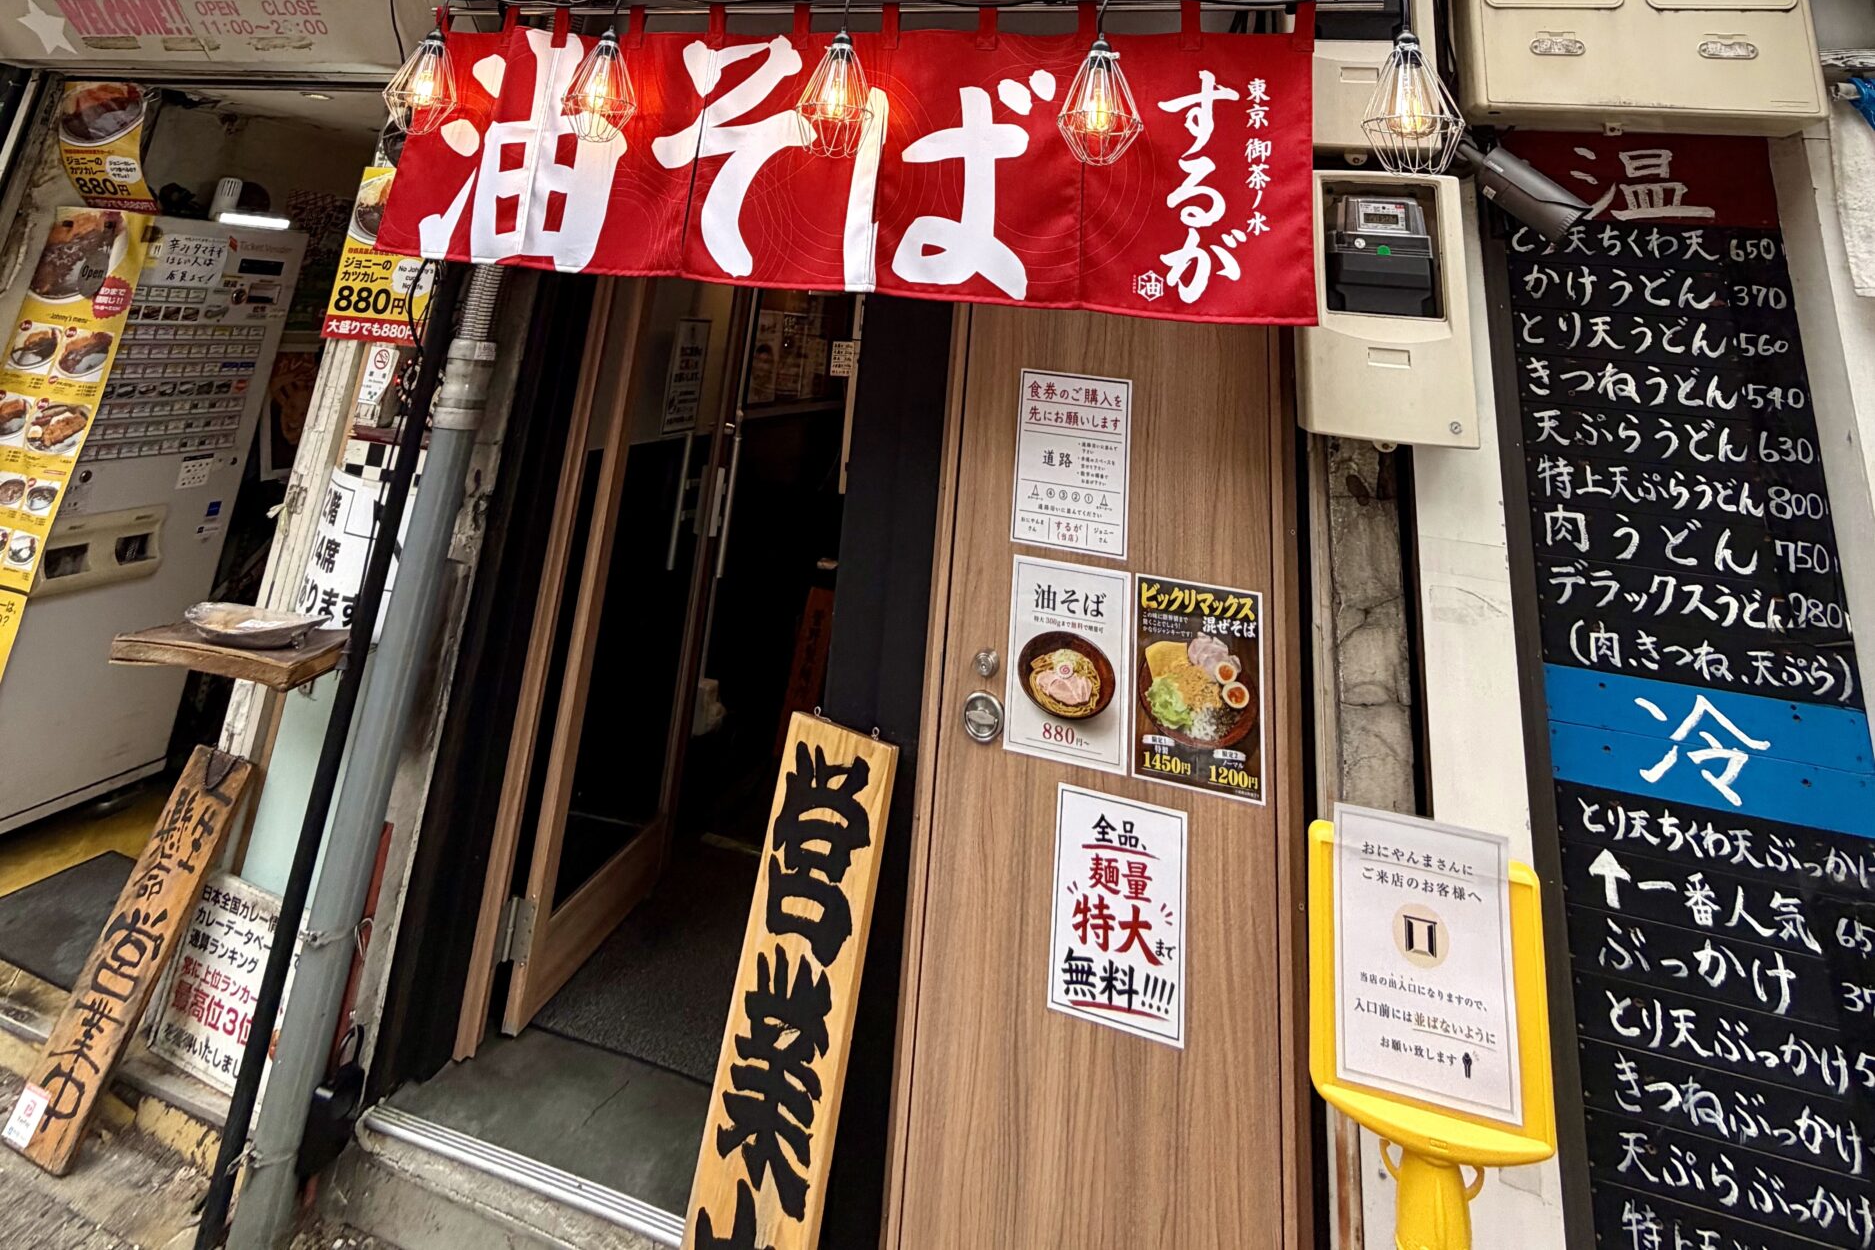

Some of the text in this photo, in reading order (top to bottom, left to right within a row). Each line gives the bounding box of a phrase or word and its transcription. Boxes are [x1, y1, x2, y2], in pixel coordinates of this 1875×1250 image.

[195, 0, 321, 17] OPEN CLOSE
[417, 28, 1056, 300] 油そば
[1244, 78, 1272, 236] 東京 御茶ノ水
[76, 177, 131, 196] 880円
[1157, 70, 1247, 304] するが
[1570, 147, 1716, 221] 温
[344, 256, 392, 270] ジョニーの
[1730, 238, 1775, 261] 650
[81, 265, 105, 281] Open
[340, 270, 389, 283] カツカレー
[1139, 272, 1163, 298] 油
[1523, 264, 1787, 310] かけうどん 370
[334, 285, 405, 316] 880円
[1520, 312, 1789, 358] とり天うどん 560
[1027, 380, 1123, 408] 食券のご購入を
[1526, 356, 1805, 410] きつねうどん 540
[1028, 405, 1121, 431] 先にお願いします
[1533, 409, 1814, 464] 天ぷらうどん 630
[1042, 449, 1073, 468] 道路
[1537, 454, 1825, 520] 特上天ぷらうどん 800
[1055, 520, 1083, 533] するが
[1544, 504, 1830, 575] 肉うどん 750
[1034, 583, 1107, 618] 油そば
[1140, 581, 1256, 621] ビックリマックス
[1549, 560, 1788, 633] デラックスうどん
[1202, 616, 1257, 639] 混ぜそば
[1143, 751, 1191, 776] 1450円
[1634, 694, 1771, 807] 冷
[1209, 764, 1259, 790] 1200円
[1088, 853, 1153, 903] 麺量
[1360, 841, 1473, 877] おにやんまさんに
[1361, 866, 1482, 903] ご来店のお客様へ
[1637, 872, 1822, 954] 一番人気
[188, 928, 259, 974] 通算ランキング
[1599, 917, 1796, 1014] ぶっかけ
[40, 908, 169, 1134] 営業中
[1354, 997, 1496, 1045] 入口前には並ばないように
[1605, 990, 1849, 1094] とり天ぶっかけ
[1379, 1036, 1457, 1067] お願い致します
[1614, 1051, 1863, 1174] きつねぶっかけ
[1616, 1132, 1875, 1248] 天ぷらぶっかけ
